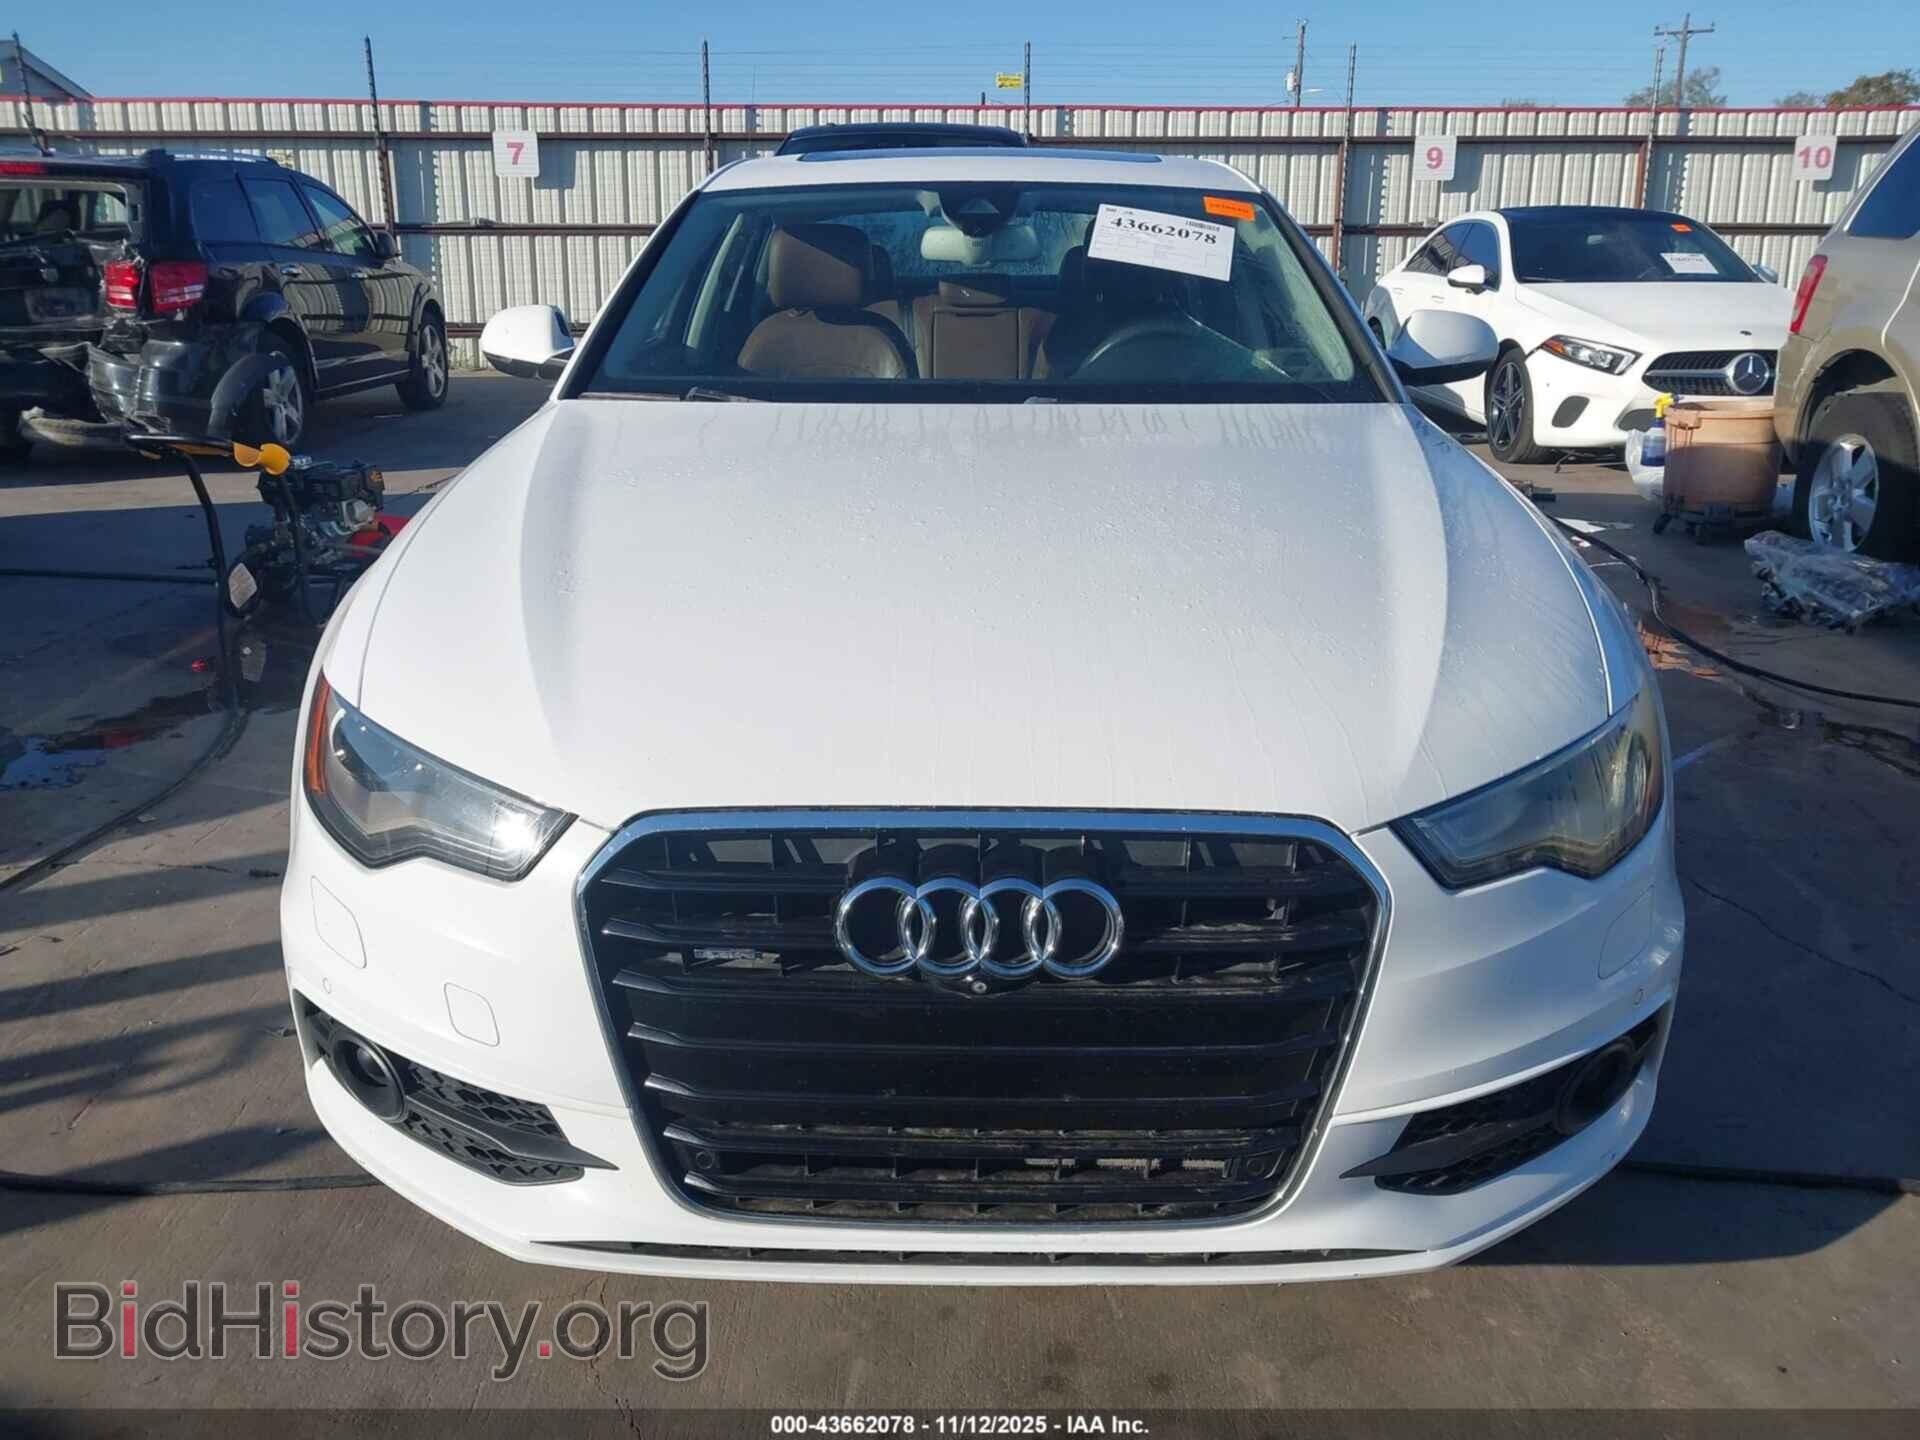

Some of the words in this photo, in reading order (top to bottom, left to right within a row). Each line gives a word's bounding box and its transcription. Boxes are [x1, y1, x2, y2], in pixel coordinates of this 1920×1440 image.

[506, 142, 524, 165] 7
[1426, 146, 1443, 169] 9
[1799, 145, 1831, 169] 10
[1110, 217, 1217, 245] 43662078
